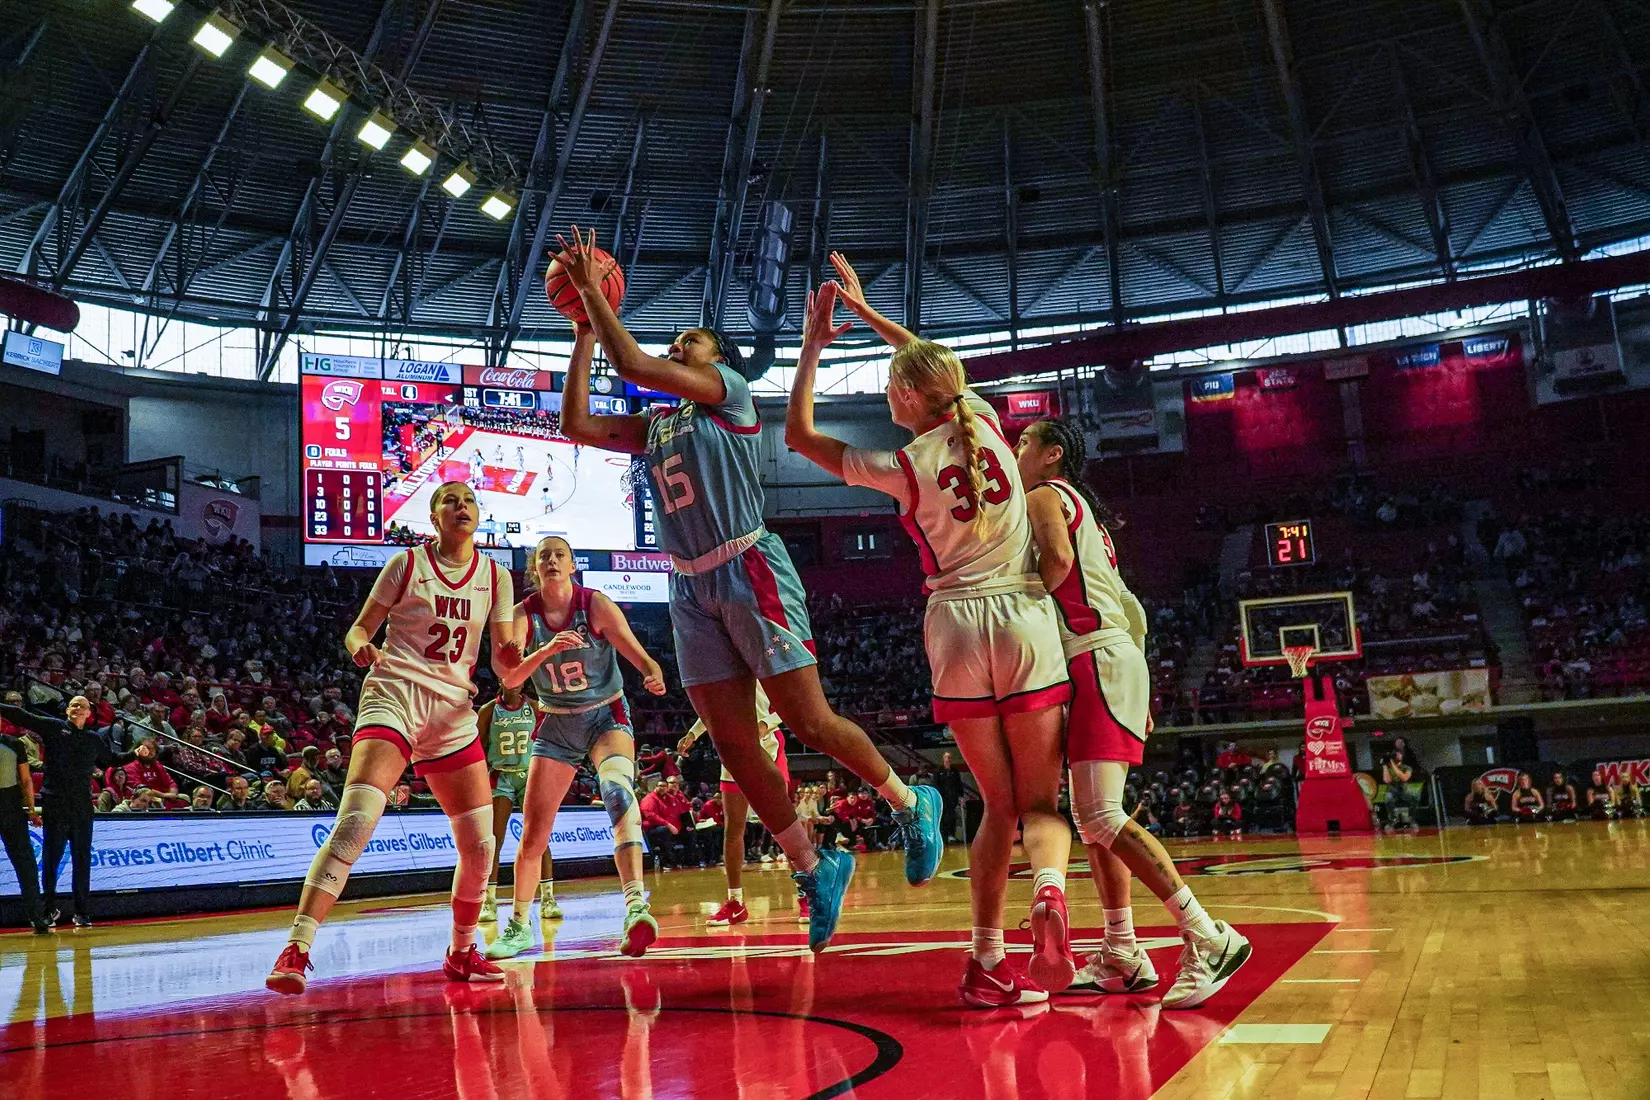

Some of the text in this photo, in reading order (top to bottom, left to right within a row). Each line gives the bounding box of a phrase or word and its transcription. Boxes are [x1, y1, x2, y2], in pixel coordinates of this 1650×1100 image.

[399, 362, 438, 375] LOGAN
[463, 388, 477, 397] 1ST
[1204, 380, 1219, 390] FIU
[498, 391, 521, 406] 7:41
[1018, 400, 1040, 408] WKU
[335, 416, 350, 440] 5
[318, 473, 323, 483] 1
[651, 453, 695, 515] 15
[937, 446, 1012, 523] 33
[317, 486, 324, 497] 3
[315, 499, 326, 509] 10
[314, 511, 327, 522] 23
[314, 525, 327, 535] 33
[1280, 525, 1307, 538] 7:41
[1278, 539, 1305, 562] 21
[435, 594, 471, 621] WKU
[424, 622, 468, 664] 23
[545, 661, 588, 694] 18
[499, 731, 530, 755] 22
[409, 832, 455, 851] Gilbert
[550, 831, 576, 844] raves
[577, 827, 609, 842] Gilbert
[90, 840, 275, 867] Graves Gilbert Clinic
